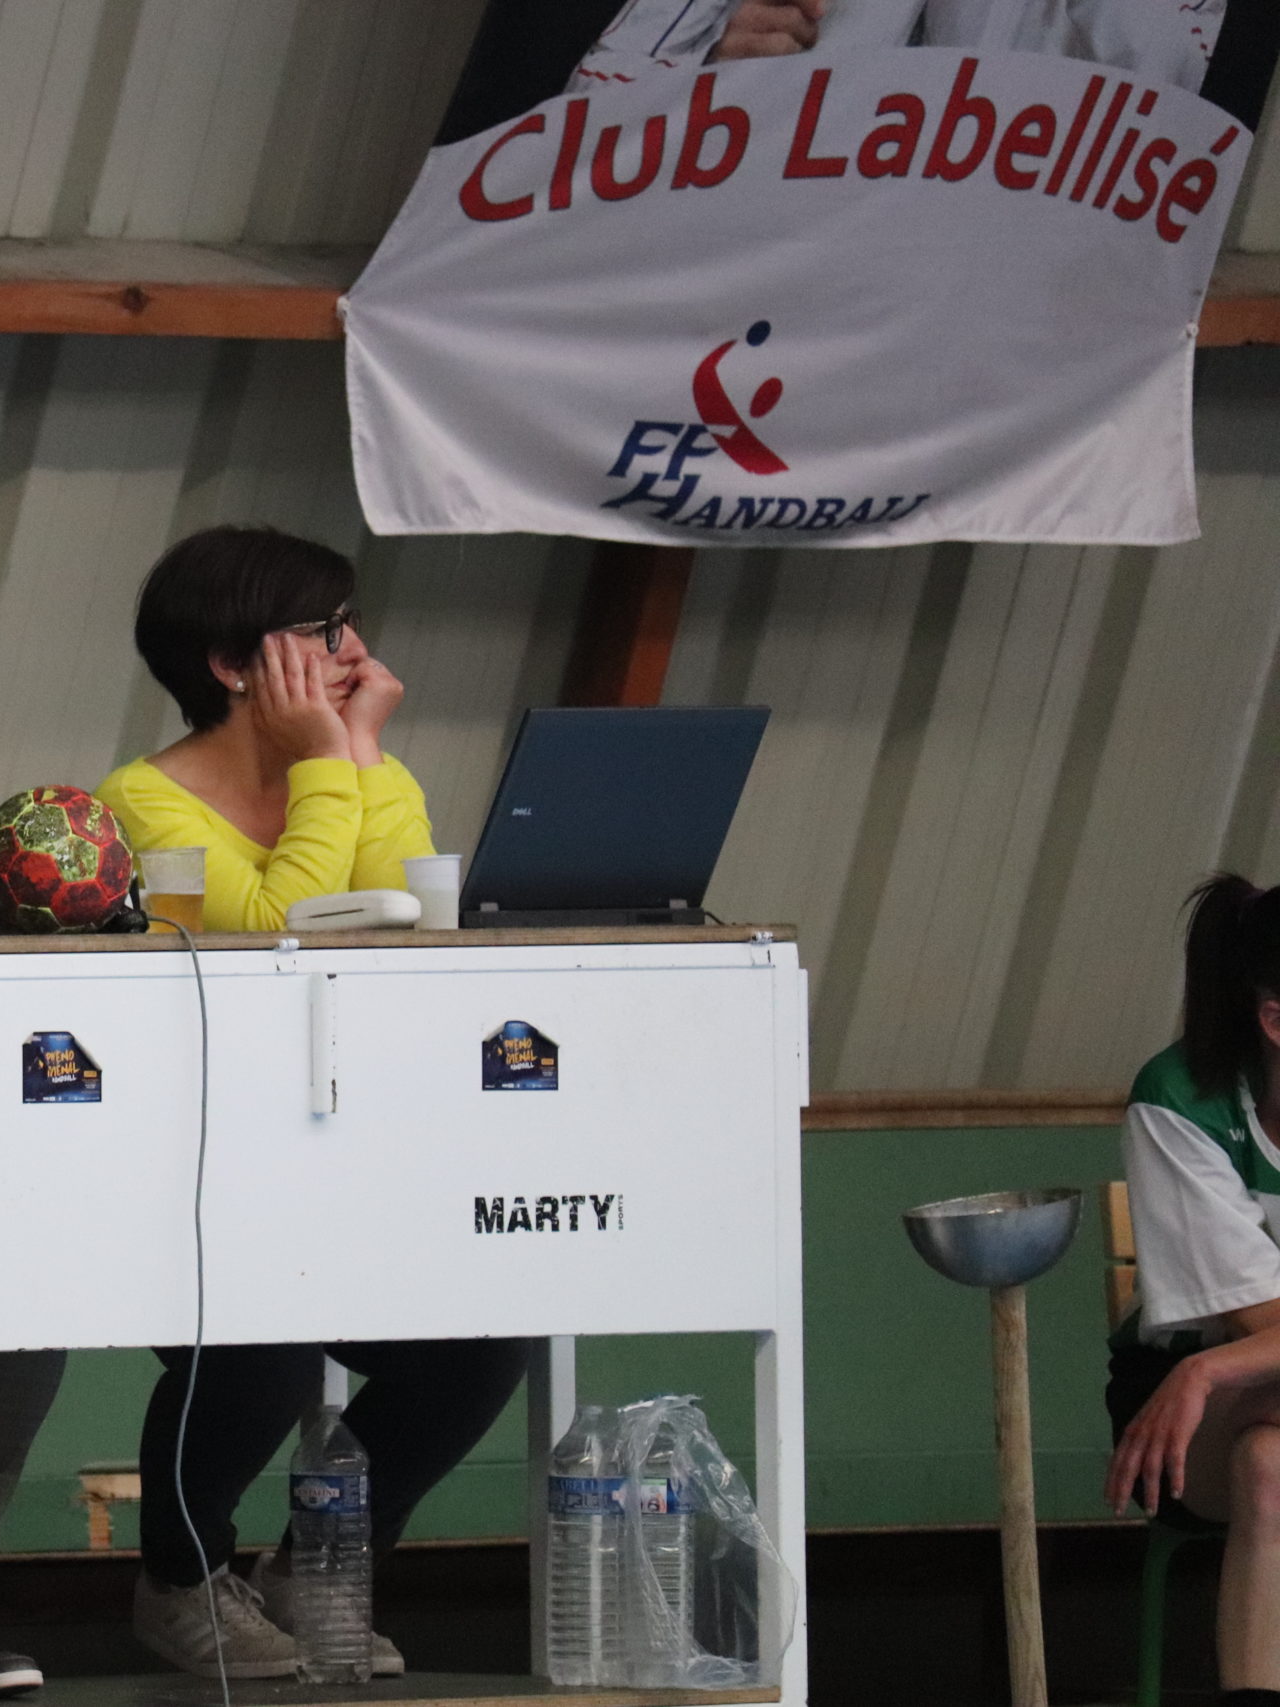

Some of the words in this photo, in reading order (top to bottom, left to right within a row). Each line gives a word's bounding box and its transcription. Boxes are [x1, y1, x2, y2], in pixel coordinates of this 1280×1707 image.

[458, 72, 751, 224] Club
[782, 57, 1239, 245] Labellisé
[511, 807, 532, 816] DELL
[474, 1194, 615, 1234] MARTY
